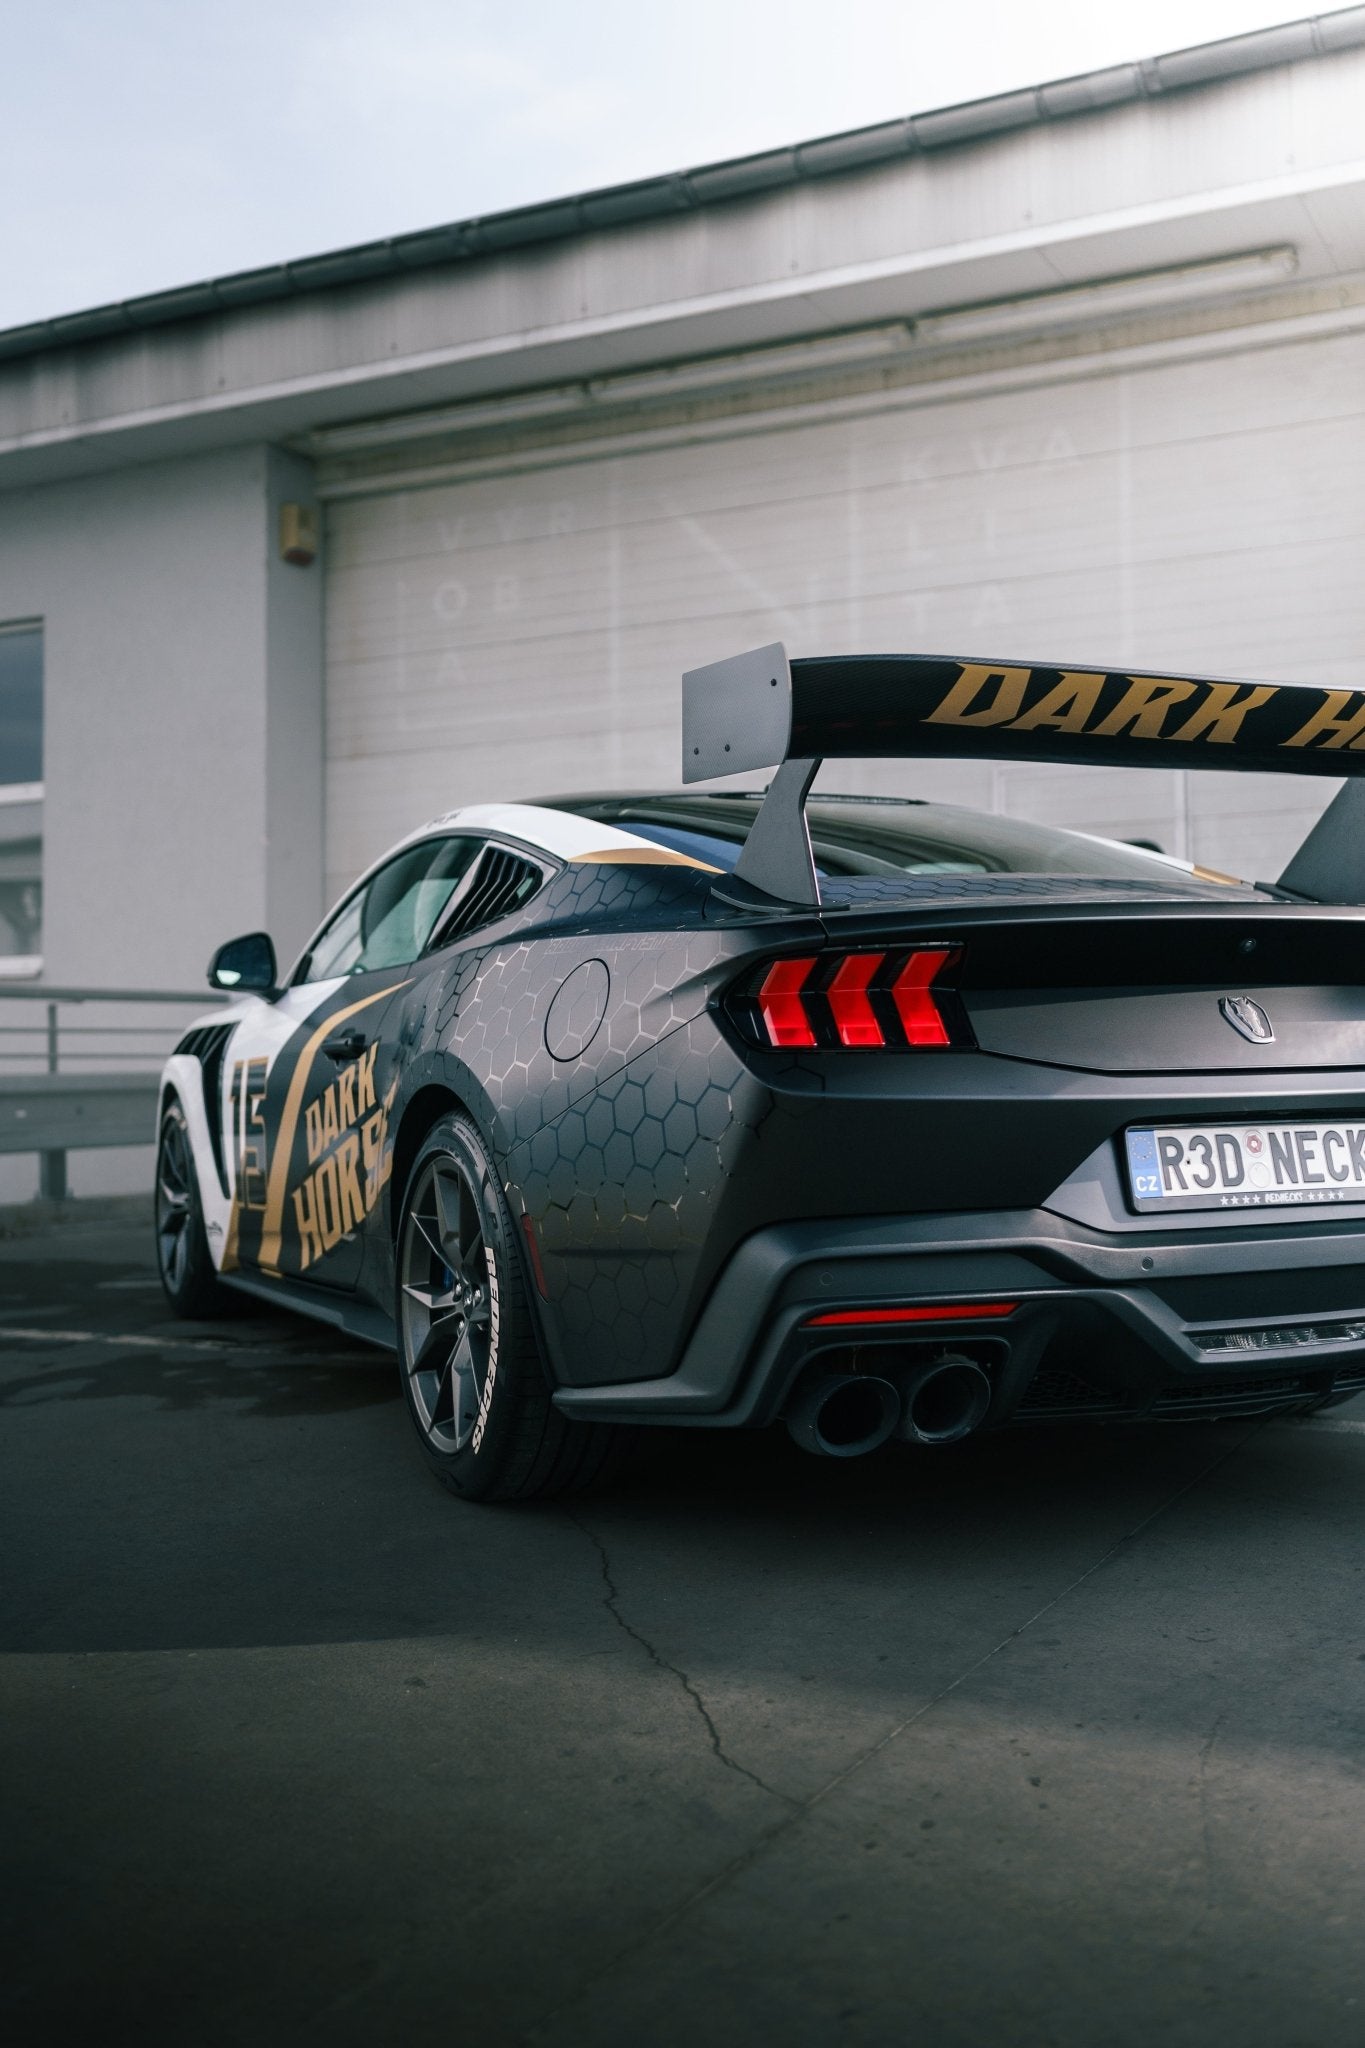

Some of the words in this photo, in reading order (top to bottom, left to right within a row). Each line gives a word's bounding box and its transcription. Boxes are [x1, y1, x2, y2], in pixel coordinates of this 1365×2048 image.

[920, 662, 1281, 744] DARK
[1278, 690, 1365, 750] H
[305, 1041, 379, 1166] DARK
[1136, 1176, 1158, 1192] CZ
[1158, 1134, 1245, 1190] R3D
[1268, 1129, 1365, 1184] NECK
